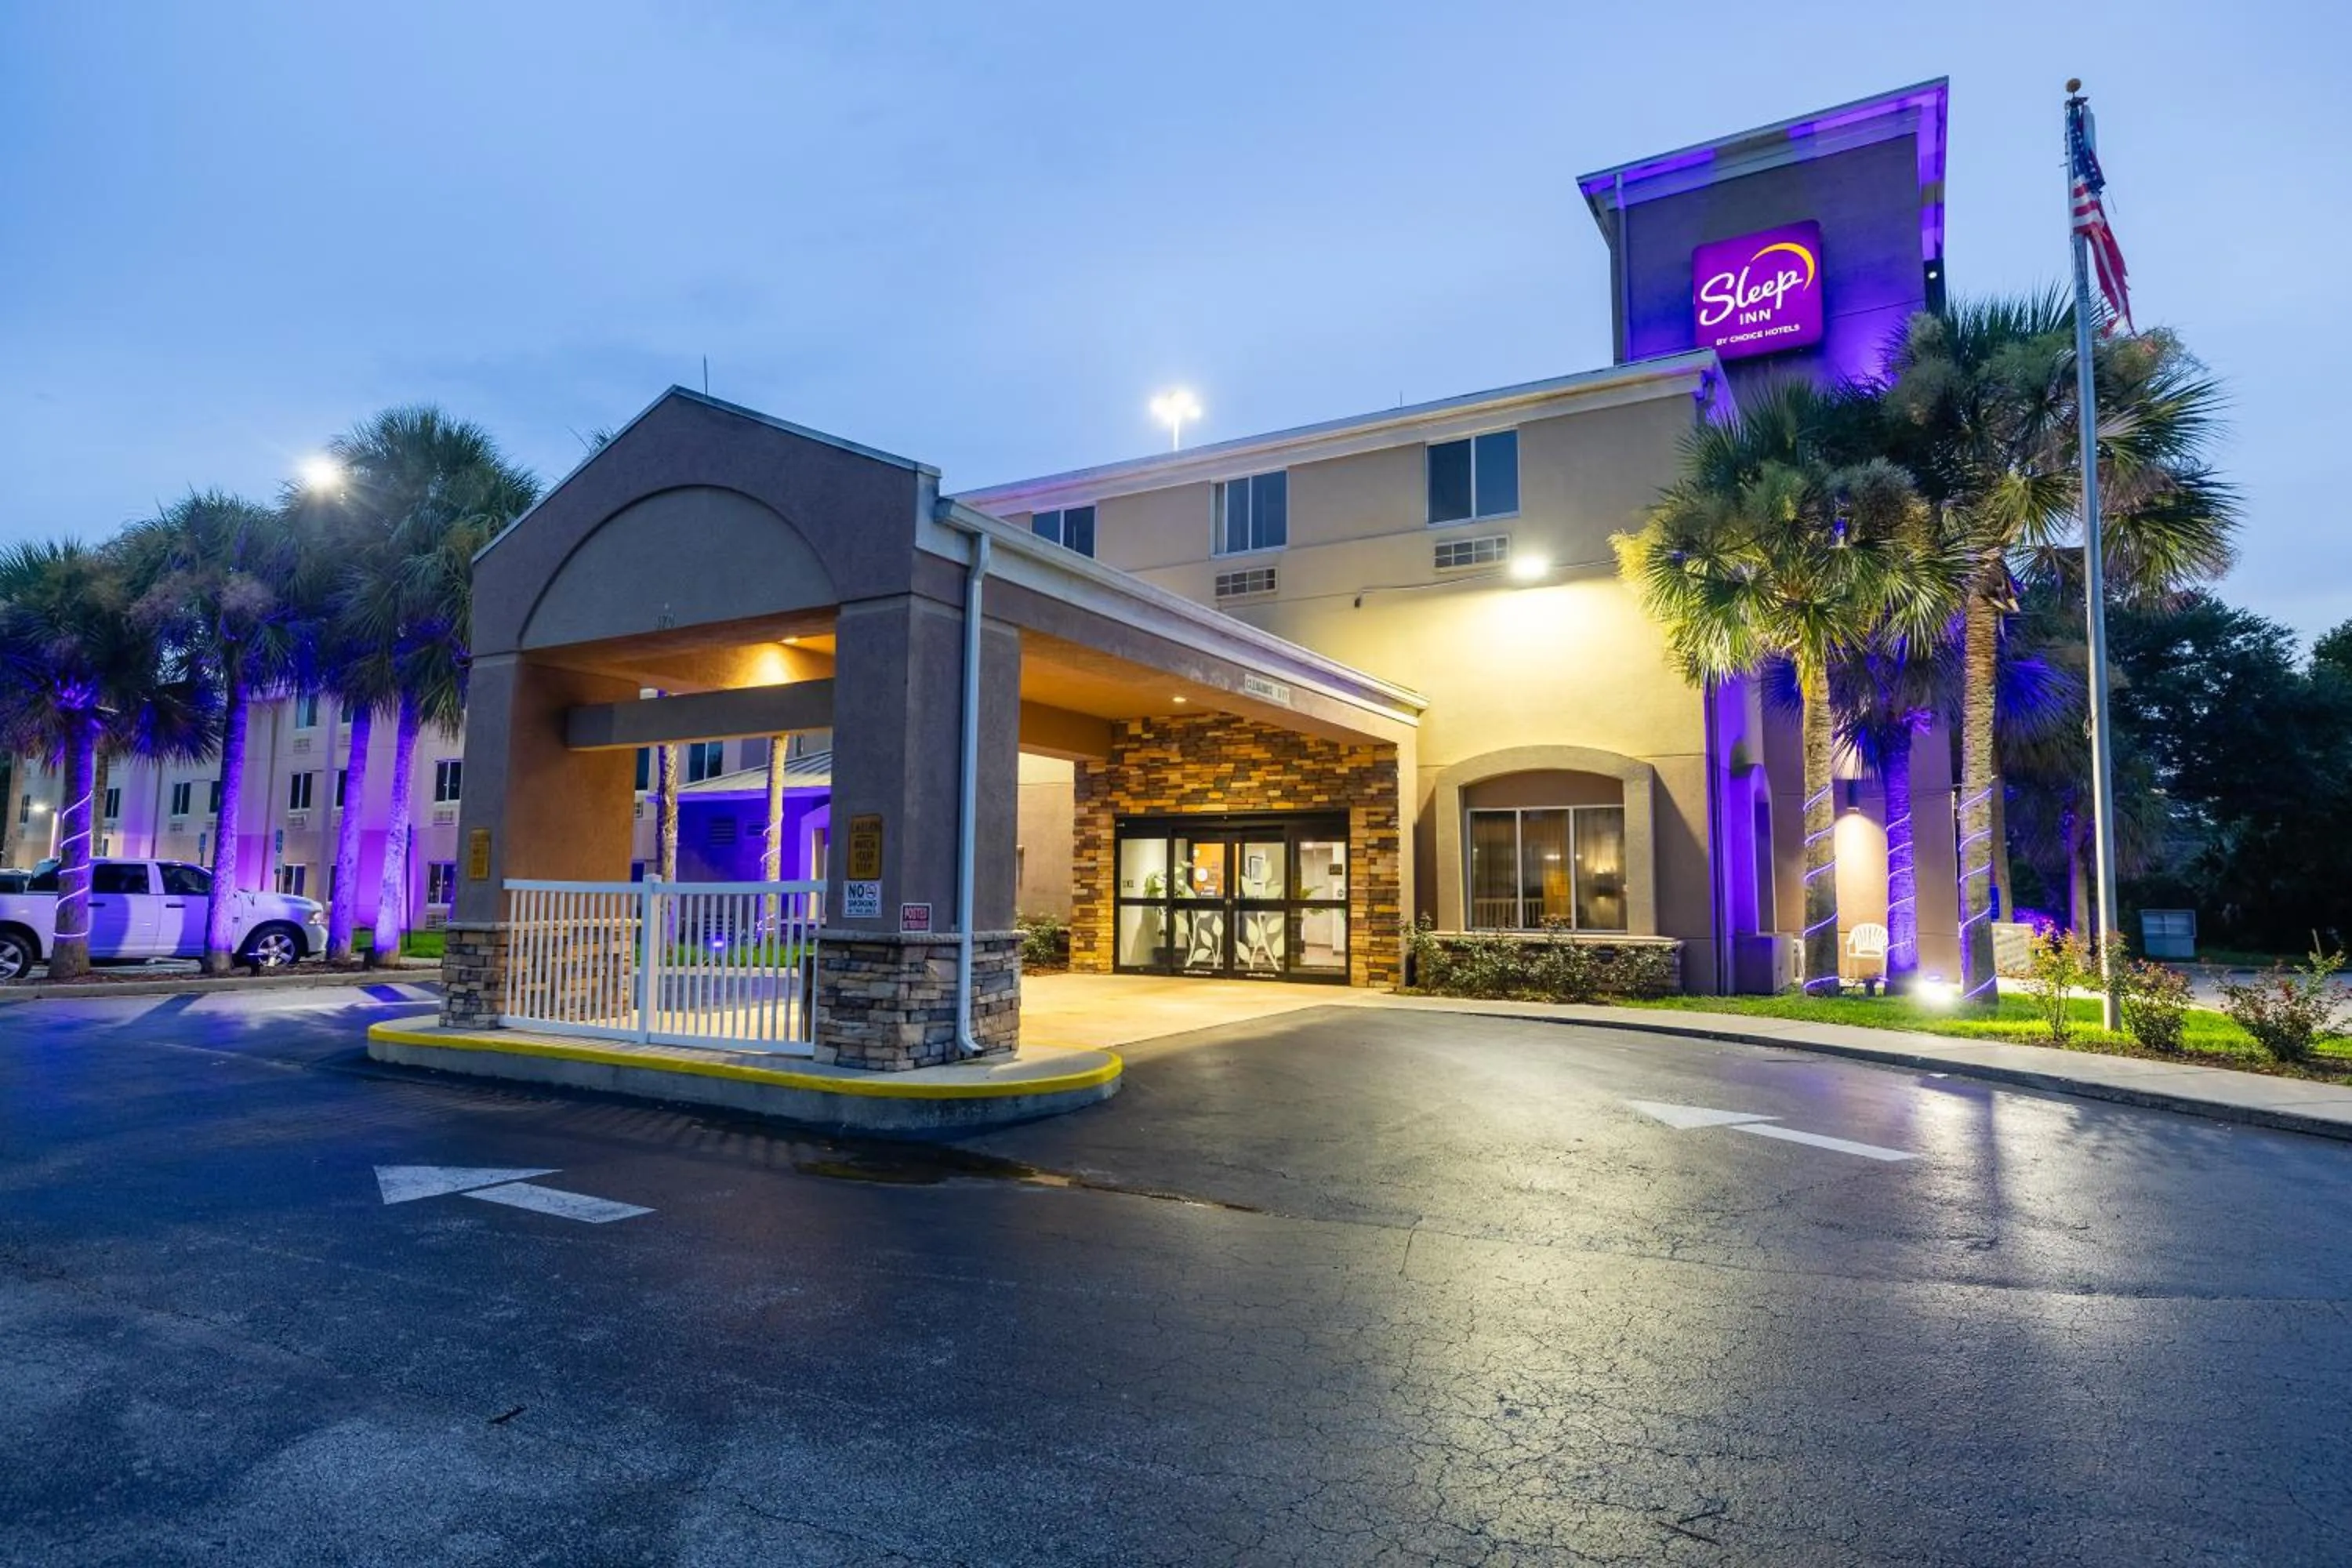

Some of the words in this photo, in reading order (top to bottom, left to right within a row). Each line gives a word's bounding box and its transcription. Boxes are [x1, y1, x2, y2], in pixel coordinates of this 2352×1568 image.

[1700, 266, 1803, 326] Sleep
[1740, 308, 1771, 325] INN
[1716, 337, 1728, 346] BY
[1730, 330, 1763, 343] CHOICE
[1765, 324, 1801, 336] HOTELS
[848, 884, 864, 898] NO
